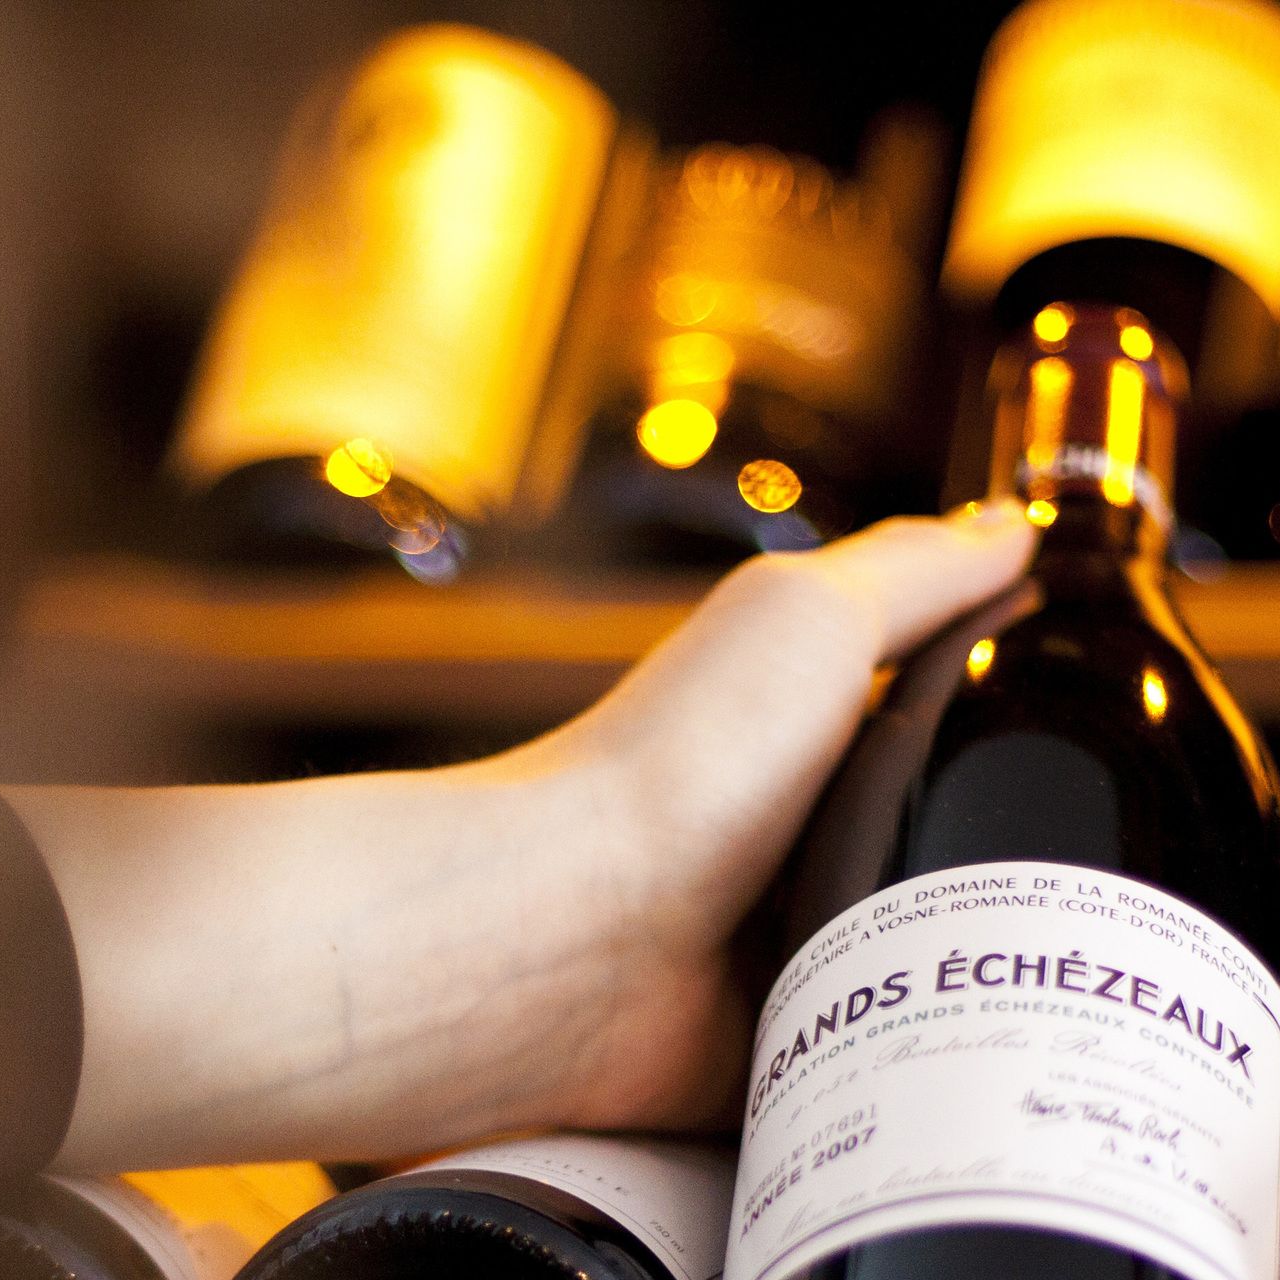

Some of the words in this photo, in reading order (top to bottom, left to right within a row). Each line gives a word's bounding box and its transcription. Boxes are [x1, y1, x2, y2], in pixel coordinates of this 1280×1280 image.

[810, 917, 861, 960] CIVILE
[873, 898, 900, 920] DU
[914, 877, 1017, 904] DOMAINE
[1033, 877, 1062, 891] DE
[1078, 882, 1103, 898] LA
[877, 895, 1049, 934] VOSNE-ROMANÉE
[1191, 943, 1249, 993] FRANCE
[749, 1036, 856, 1144] APPELLATION
[866, 1003, 965, 1039] GRANDS
[979, 1000, 1126, 1031] ÉCHÉZEAUX
[750, 970, 913, 1119] GRANDS
[935, 948, 1254, 1085] ÉCHÉZEAUX
[740, 1165, 803, 1244] ANNÉE
[812, 1125, 877, 1171] 2007
